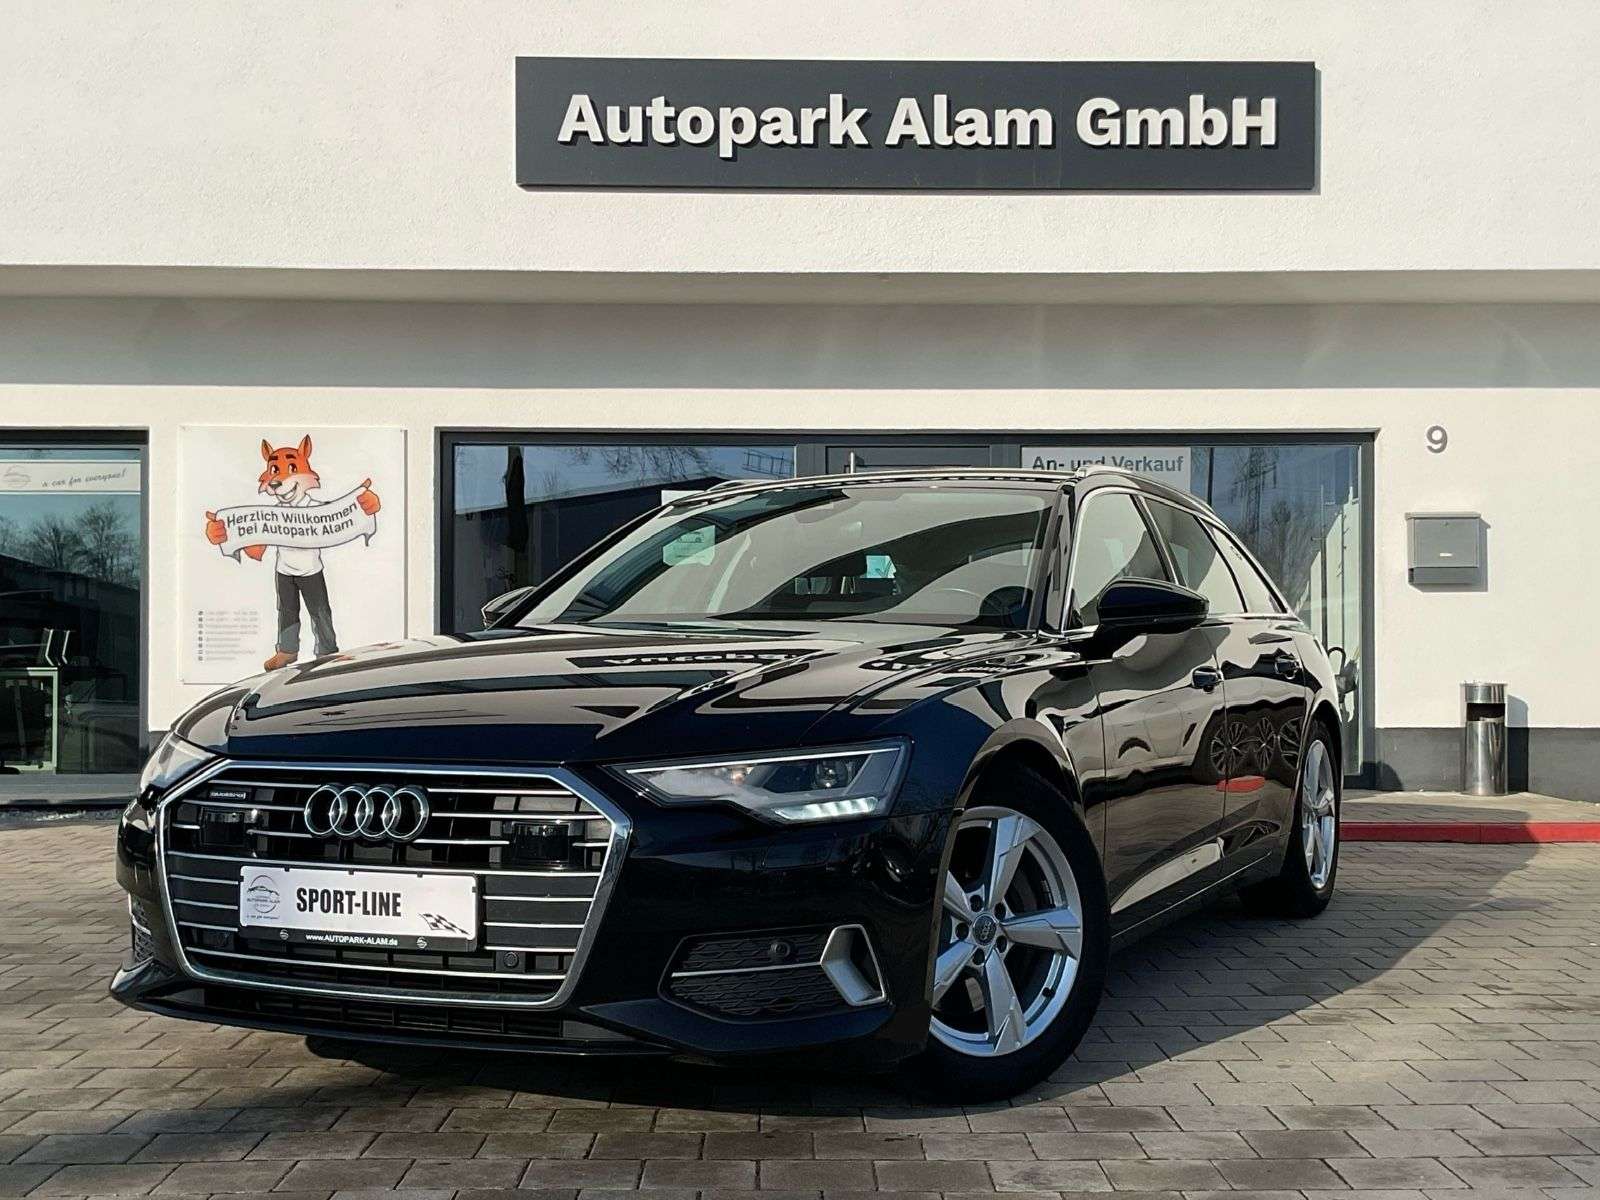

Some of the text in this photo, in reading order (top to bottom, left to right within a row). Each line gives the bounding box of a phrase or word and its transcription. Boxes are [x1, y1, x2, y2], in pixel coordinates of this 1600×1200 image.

[557, 93, 1278, 158] Autopark Alam GmbH
[1426, 425, 1448, 454] 9
[1032, 456, 1064, 471] An-
[1111, 456, 1183, 472] Verkauf
[226, 502, 358, 528] Herzlich Willkommen
[237, 518, 354, 539] bei Autopark Alam
[296, 887, 402, 918] SPORT-LINE
